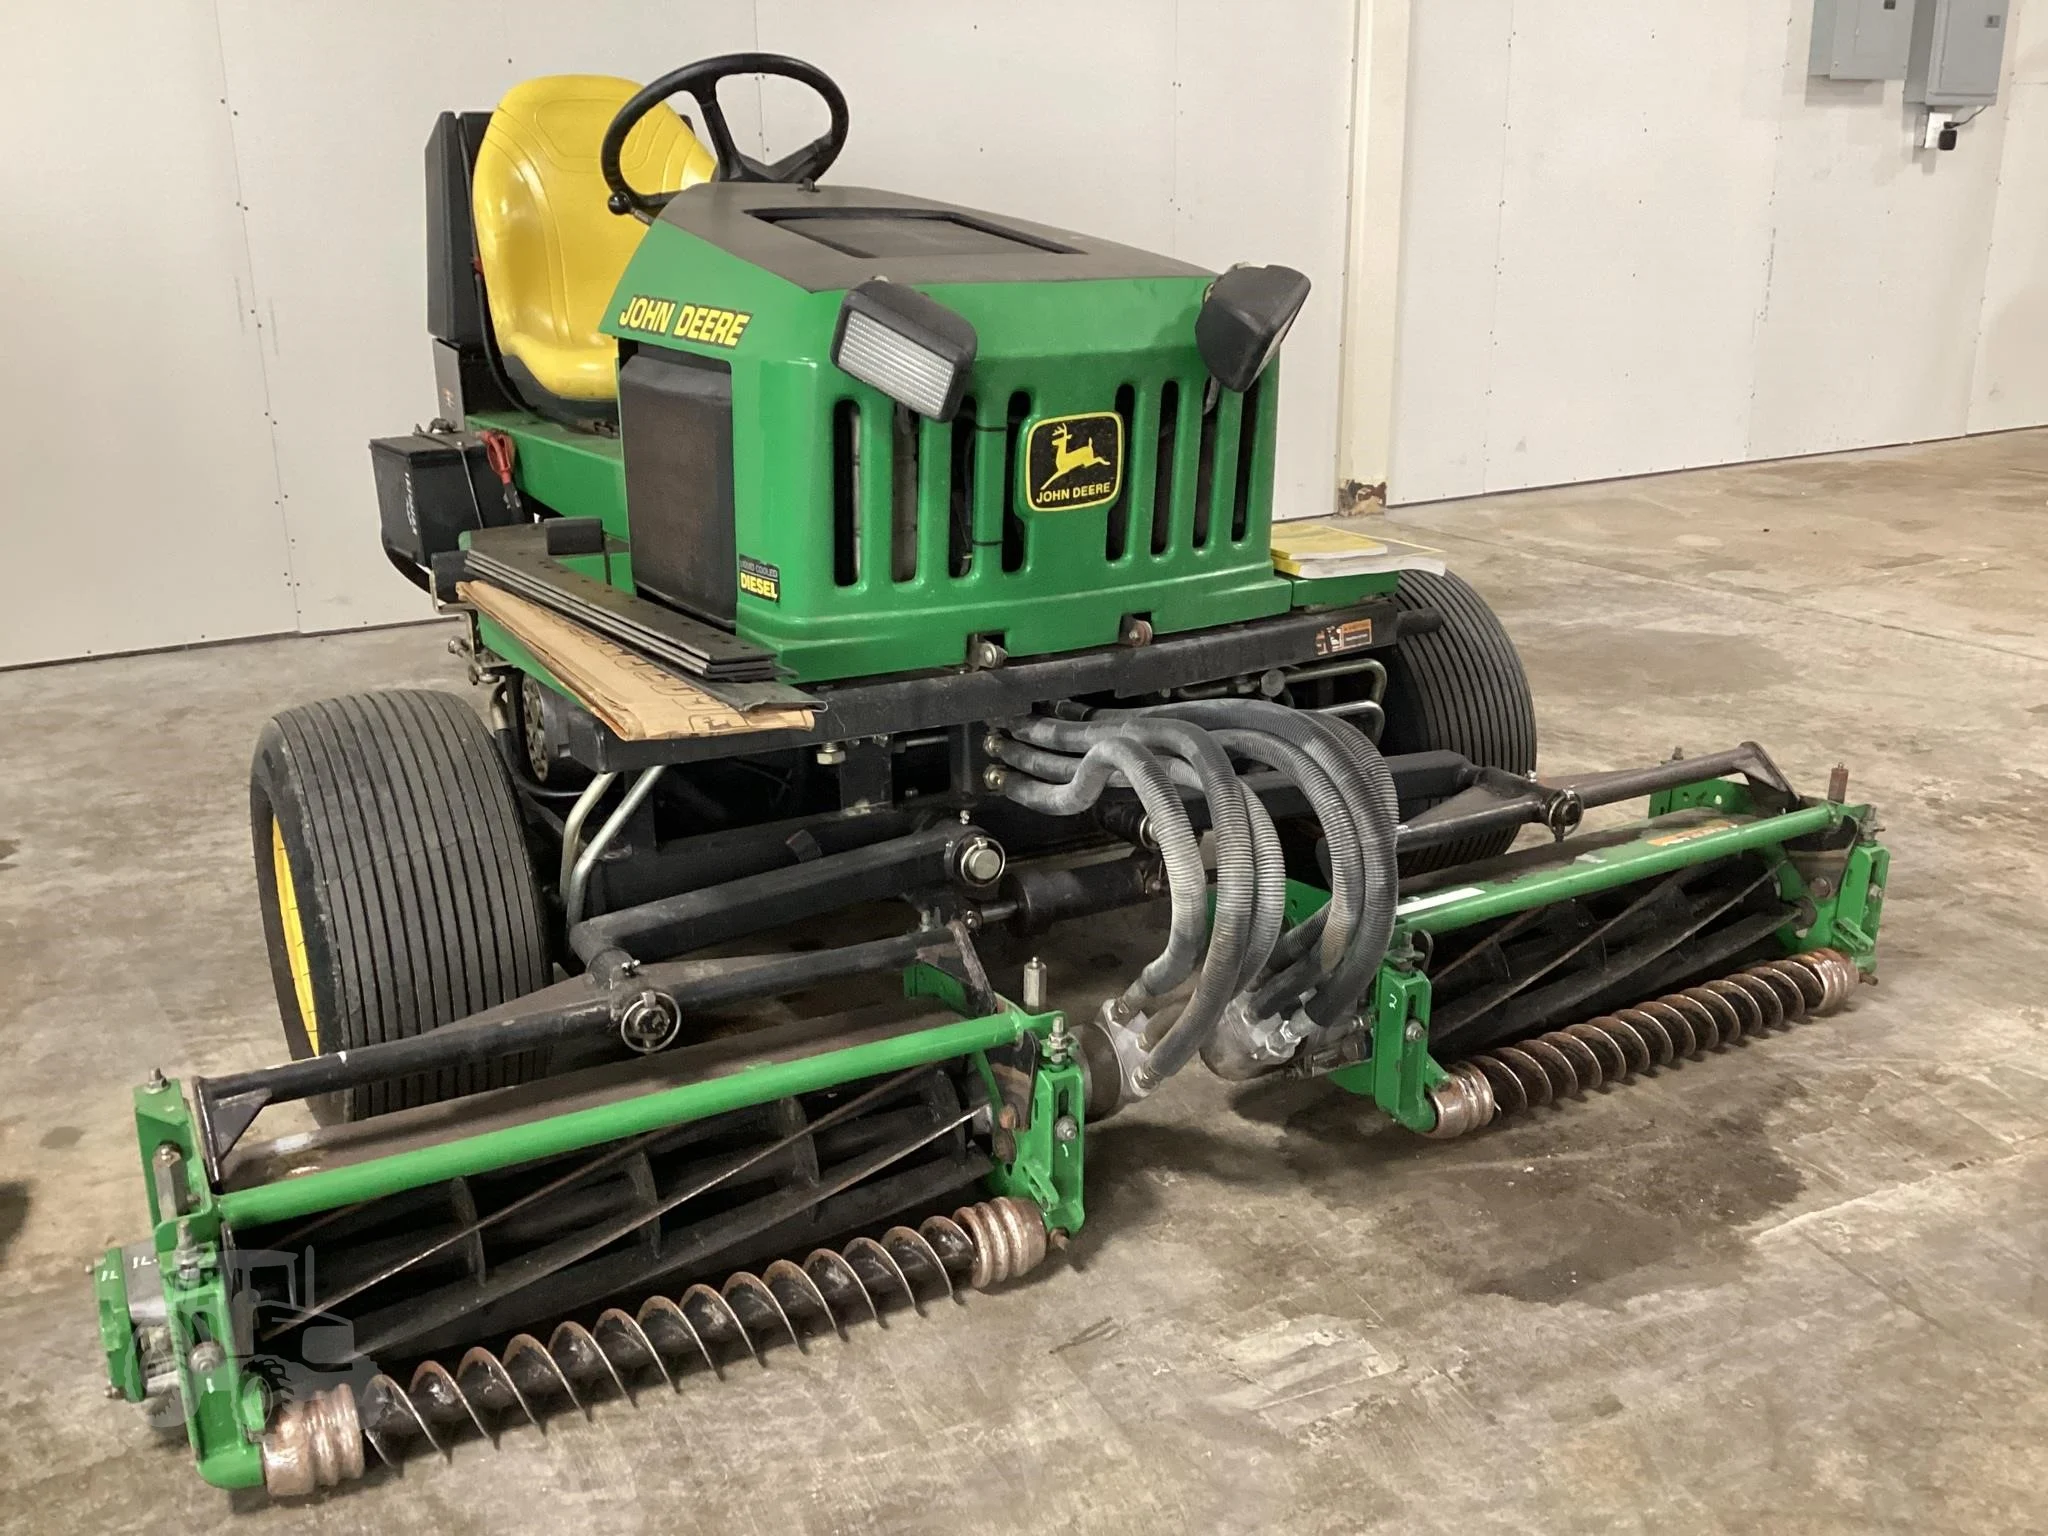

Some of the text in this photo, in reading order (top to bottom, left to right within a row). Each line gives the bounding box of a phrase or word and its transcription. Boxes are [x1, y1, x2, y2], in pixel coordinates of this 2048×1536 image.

[619, 295, 751, 347] JOHN DEERE
[1036, 482, 1111, 503] JOHN DEERE
[740, 572, 778, 599] DIESEL
